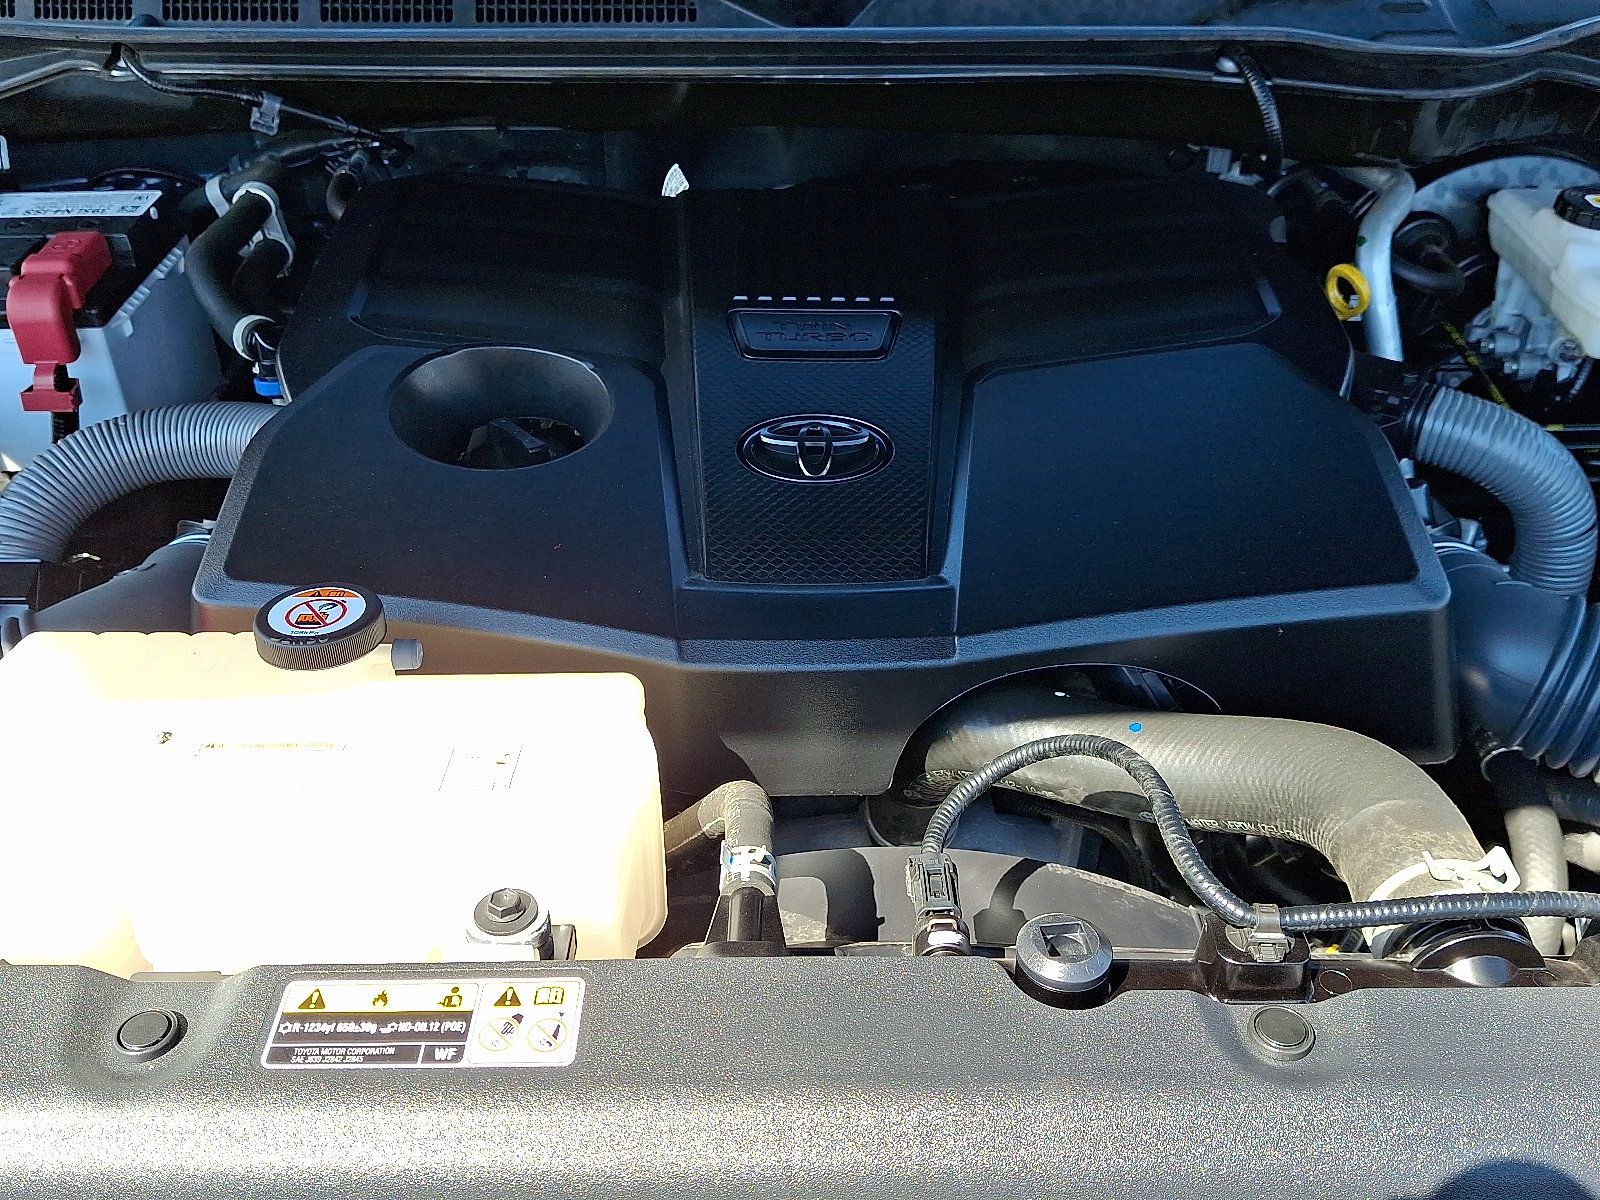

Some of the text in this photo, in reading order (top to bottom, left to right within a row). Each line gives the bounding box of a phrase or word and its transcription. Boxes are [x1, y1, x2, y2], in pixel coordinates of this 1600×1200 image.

[756, 331, 873, 342] TURBO
[441, 1021, 467, 1034] (POE)
[294, 1046, 396, 1056] TOYOTA MOTOR CORPORATION
[434, 1047, 458, 1061] WF
[290, 1055, 306, 1064] SAE
